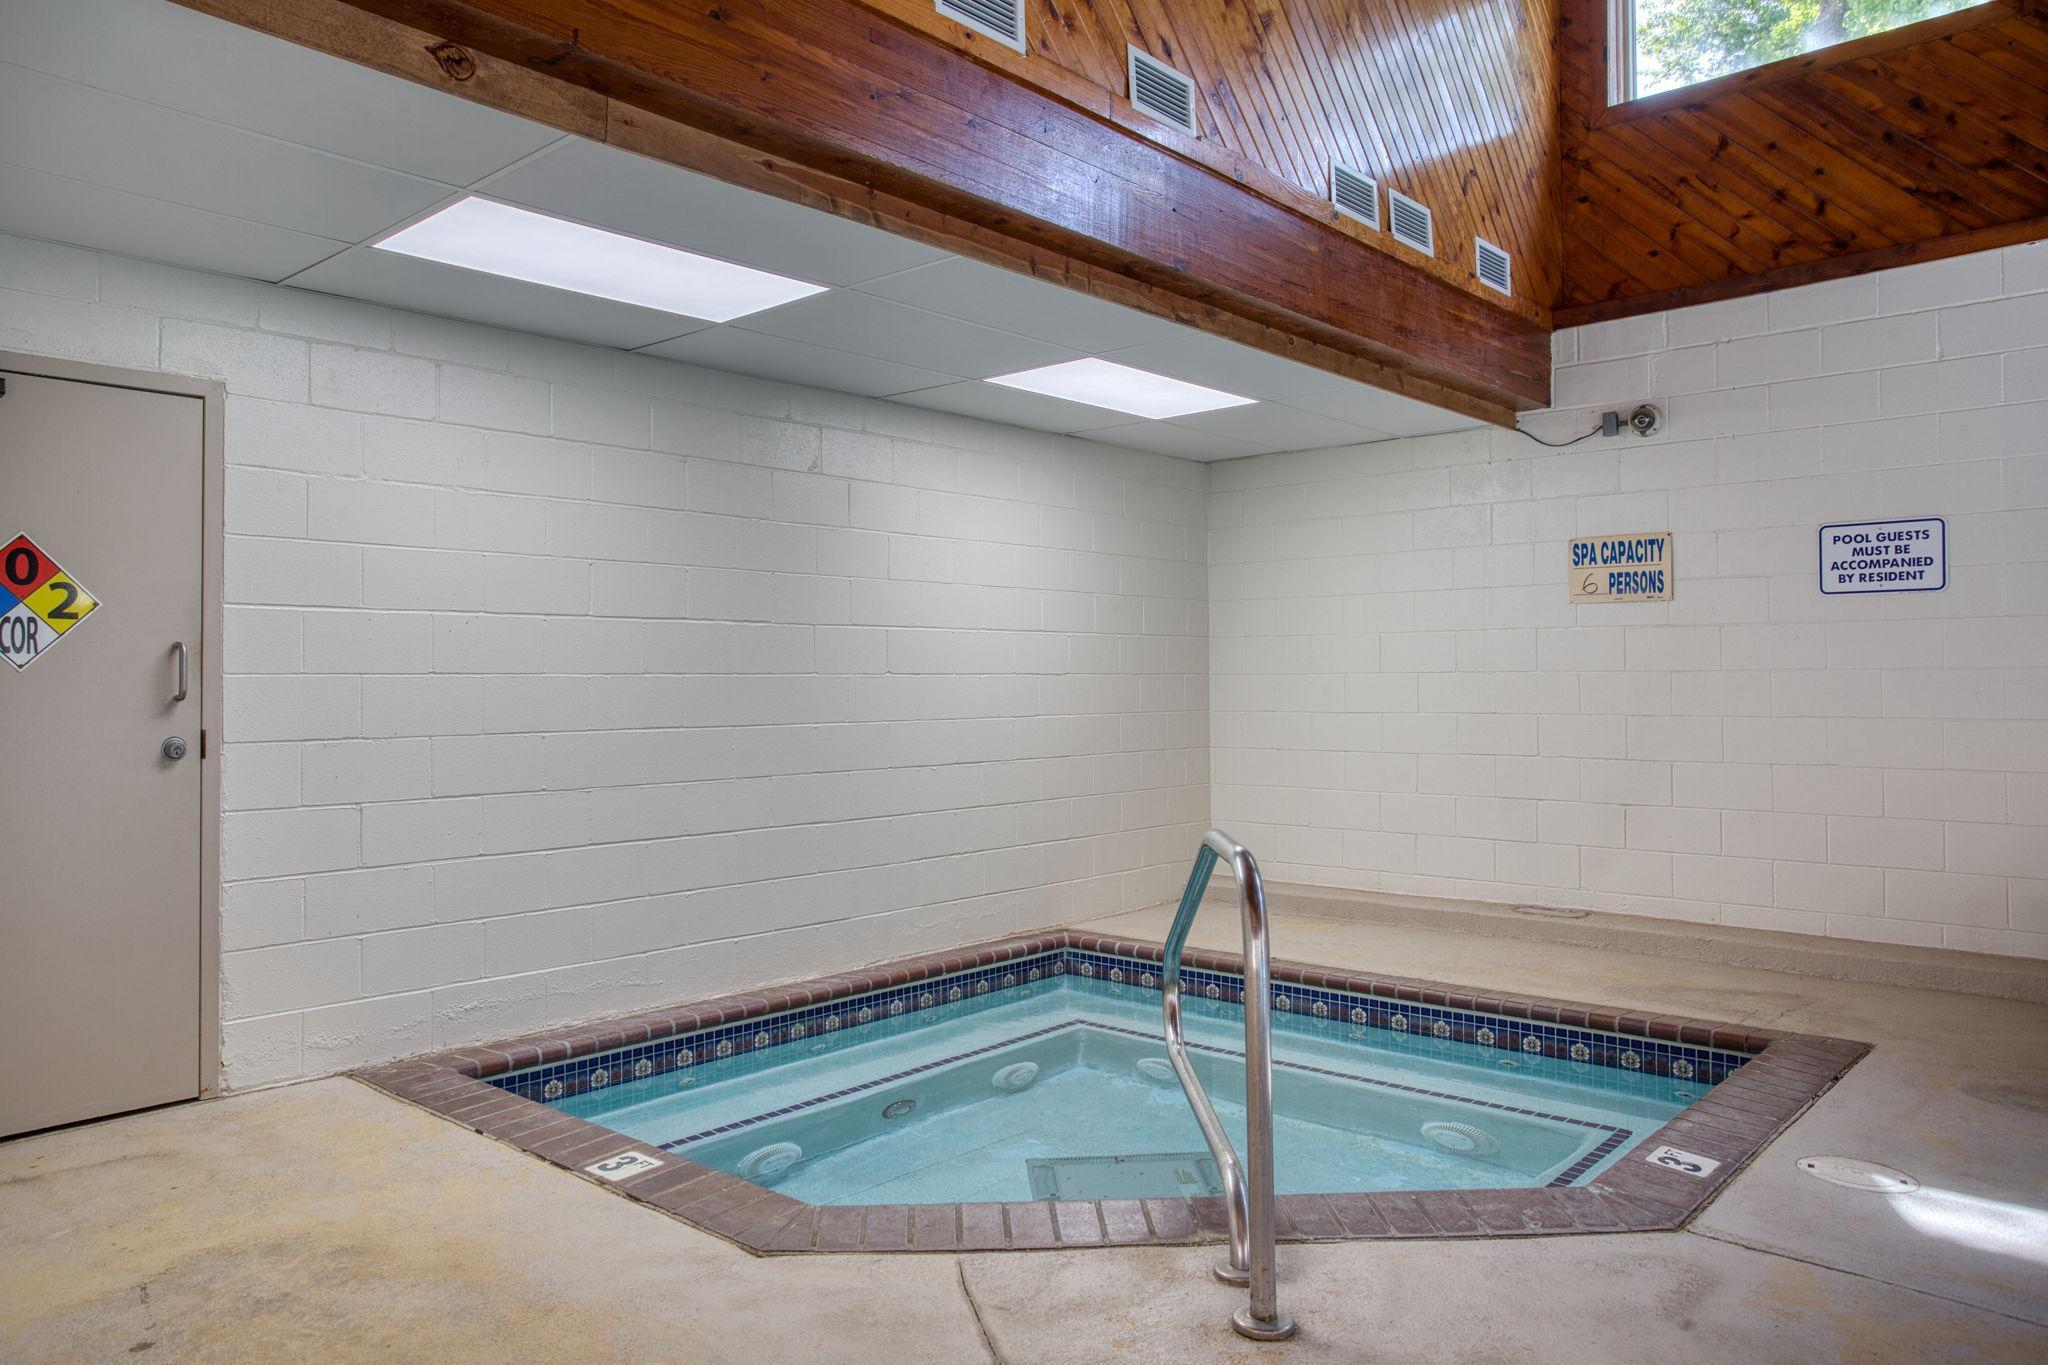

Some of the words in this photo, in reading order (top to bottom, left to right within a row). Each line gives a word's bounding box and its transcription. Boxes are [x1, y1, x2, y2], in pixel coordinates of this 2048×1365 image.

[1833, 534, 1871, 545] POOL
[1876, 530, 1929, 542] GUESTS
[1573, 543, 1597, 566] SPA
[1601, 538, 1664, 565] CAPACITY
[1852, 545, 1890, 557] MUST
[1894, 544, 1910, 555] BE
[5, 547, 38, 585] 0
[1831, 556, 1933, 571] ACCOMPANIED
[1582, 573, 1598, 594] 6
[1609, 570, 1664, 594] PERSONS
[1838, 573, 1855, 583] BY
[1859, 570, 1925, 583] RESIDENT
[48, 581, 79, 620] 2
[0, 616, 38, 654] COR
[597, 1156, 639, 1172] 3
[634, 1160, 655, 1169] FT
[1658, 1156, 1702, 1173] 3
